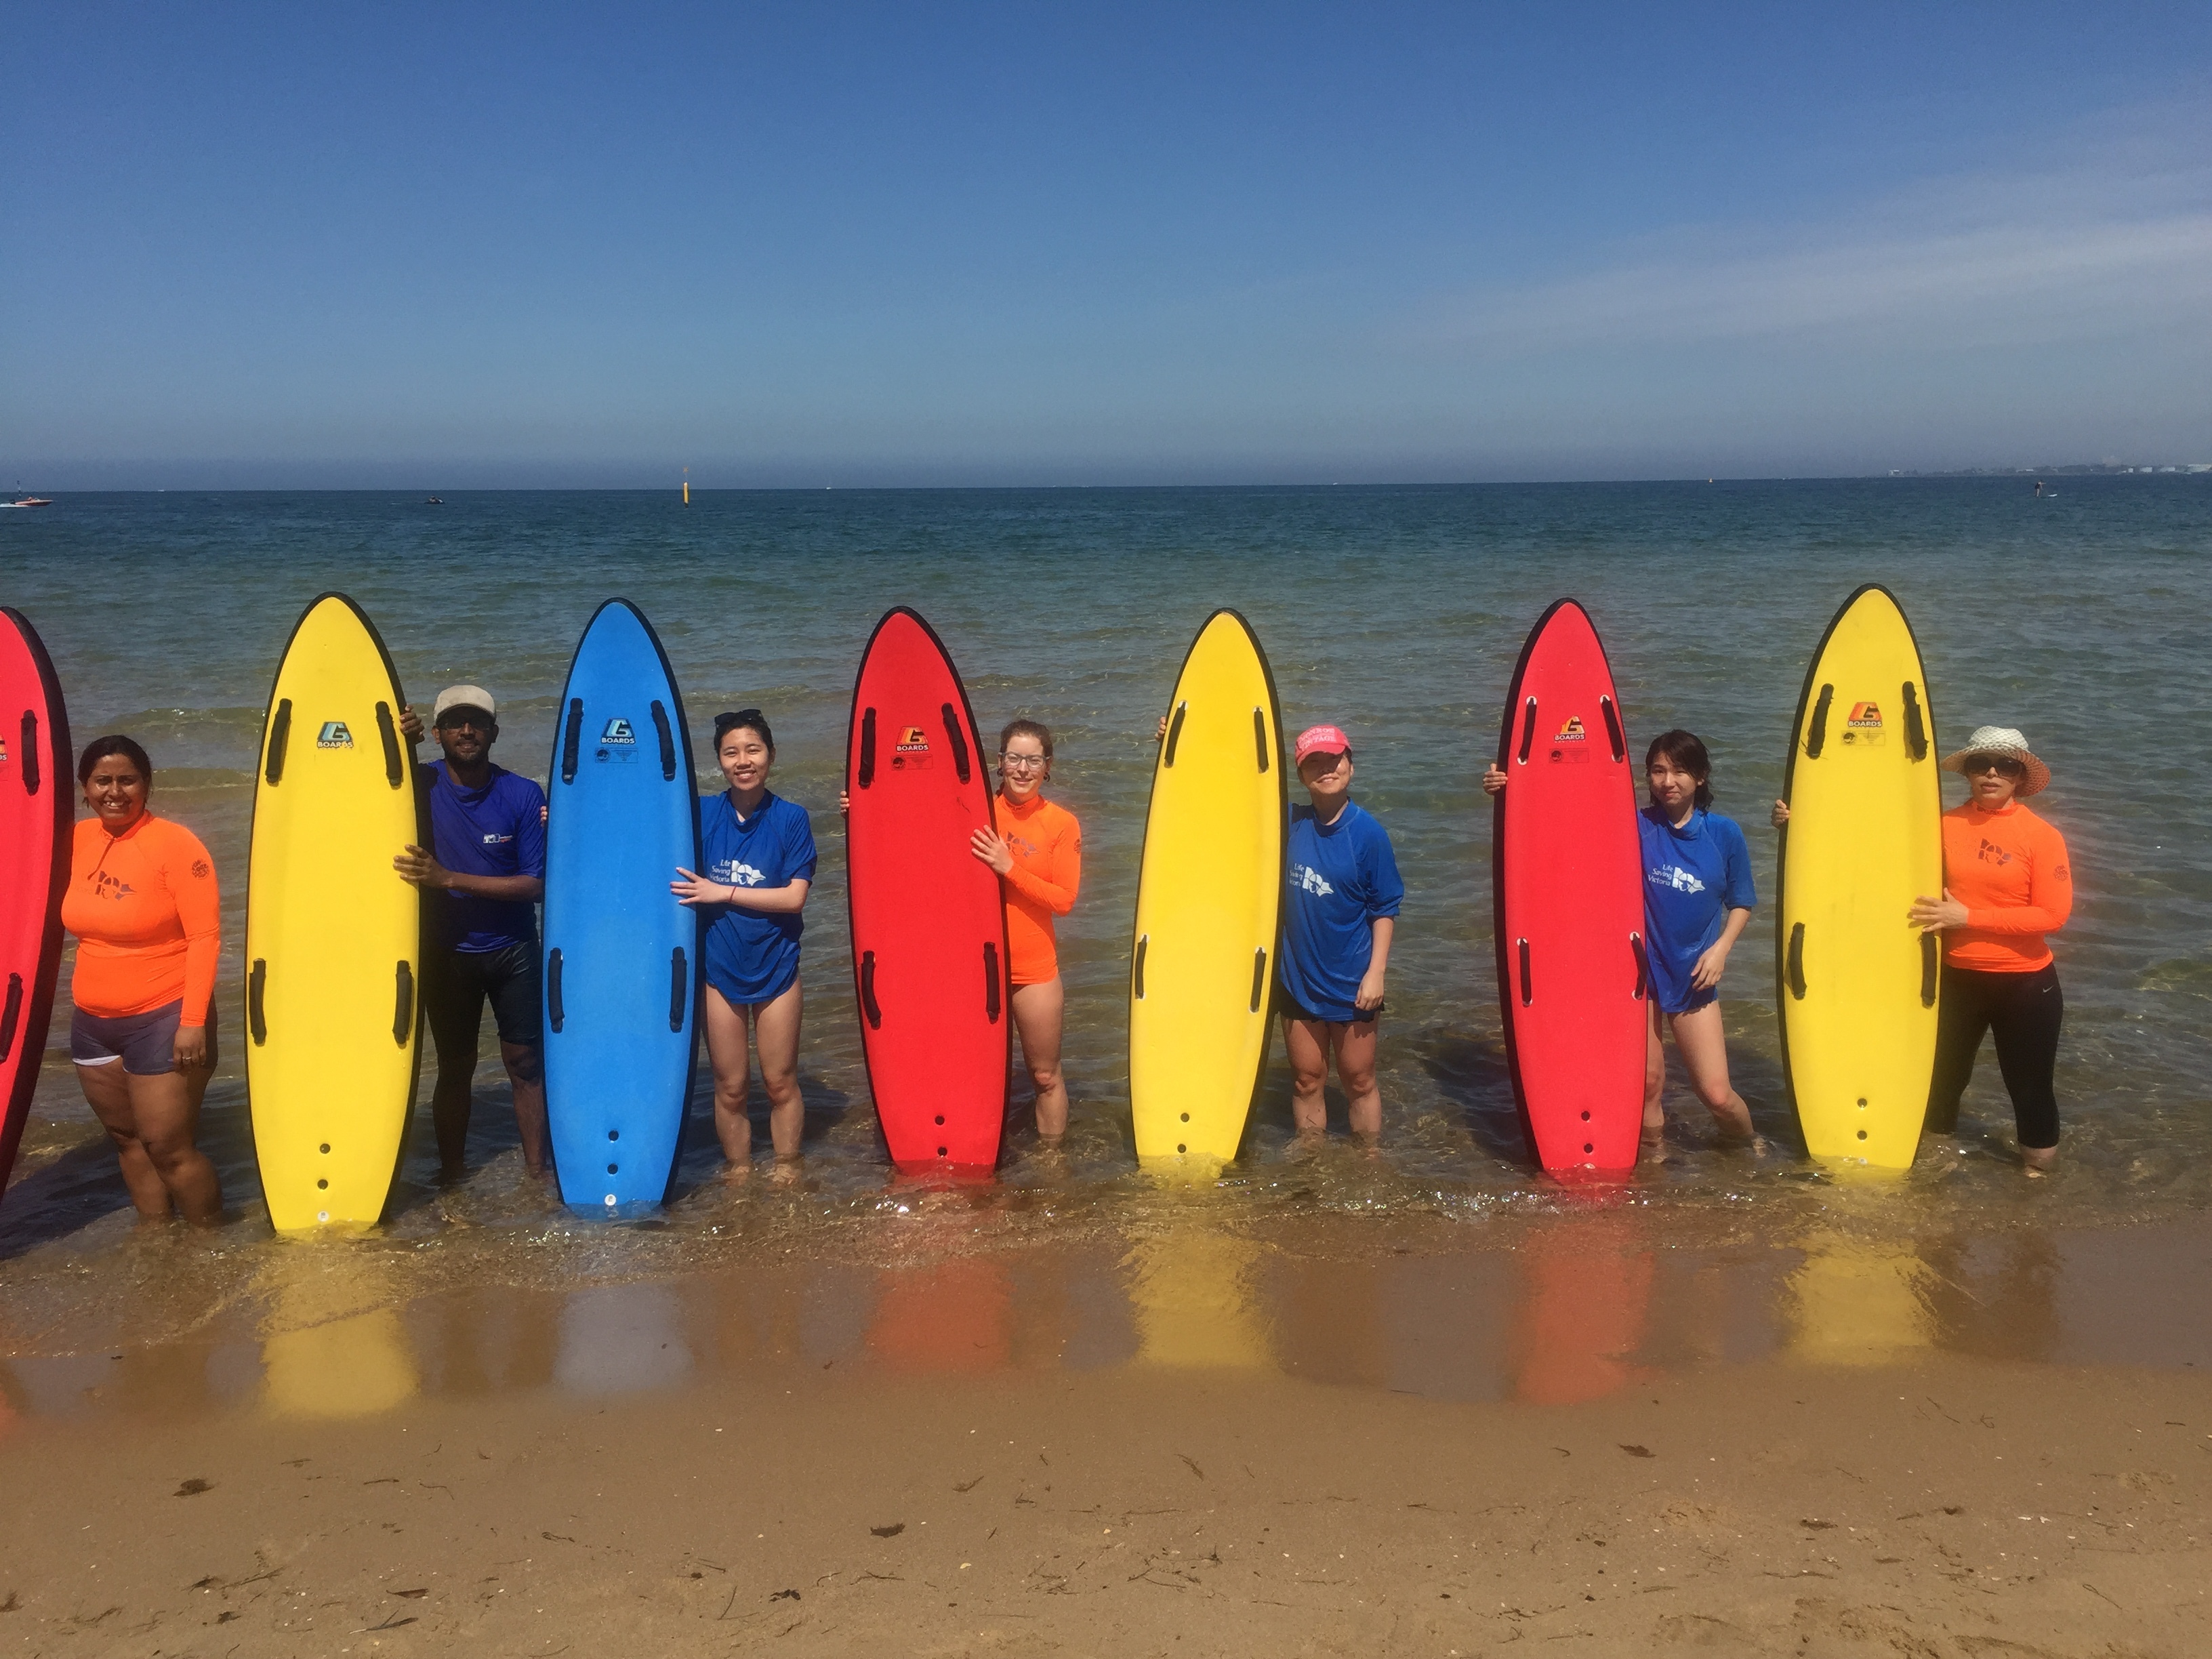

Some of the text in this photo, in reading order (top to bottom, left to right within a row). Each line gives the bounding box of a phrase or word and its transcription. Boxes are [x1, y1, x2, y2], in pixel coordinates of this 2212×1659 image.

[720, 859, 731, 867] Life
[1294, 863, 1305, 872] Life
[1662, 863, 1673, 872] Life
[712, 865, 731, 876] Saving
[1652, 867, 1673, 880] Saving
[1647, 874, 1671, 886] Victoria
